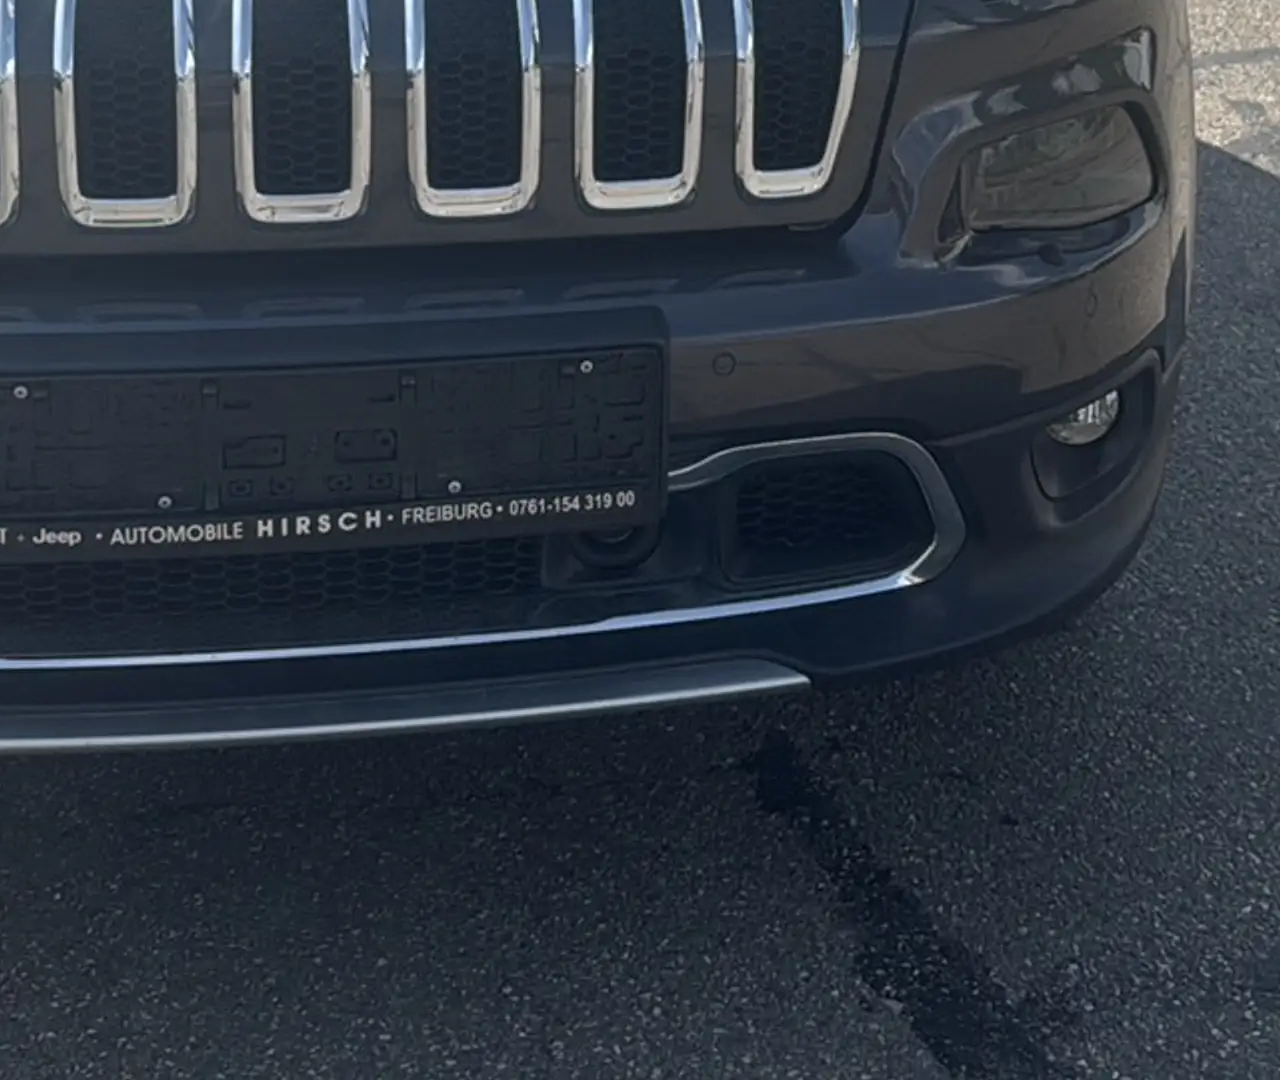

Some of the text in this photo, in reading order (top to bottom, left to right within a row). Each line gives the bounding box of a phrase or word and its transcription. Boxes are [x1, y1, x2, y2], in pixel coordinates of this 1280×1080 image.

[32, 528, 82, 547] Jeep
[110, 521, 244, 545] AUTOMOBILE
[402, 501, 493, 525] FREIBURG
[509, 495, 580, 517] 0761-154
[584, 493, 613, 511] 319
[616, 490, 636, 507] 00
